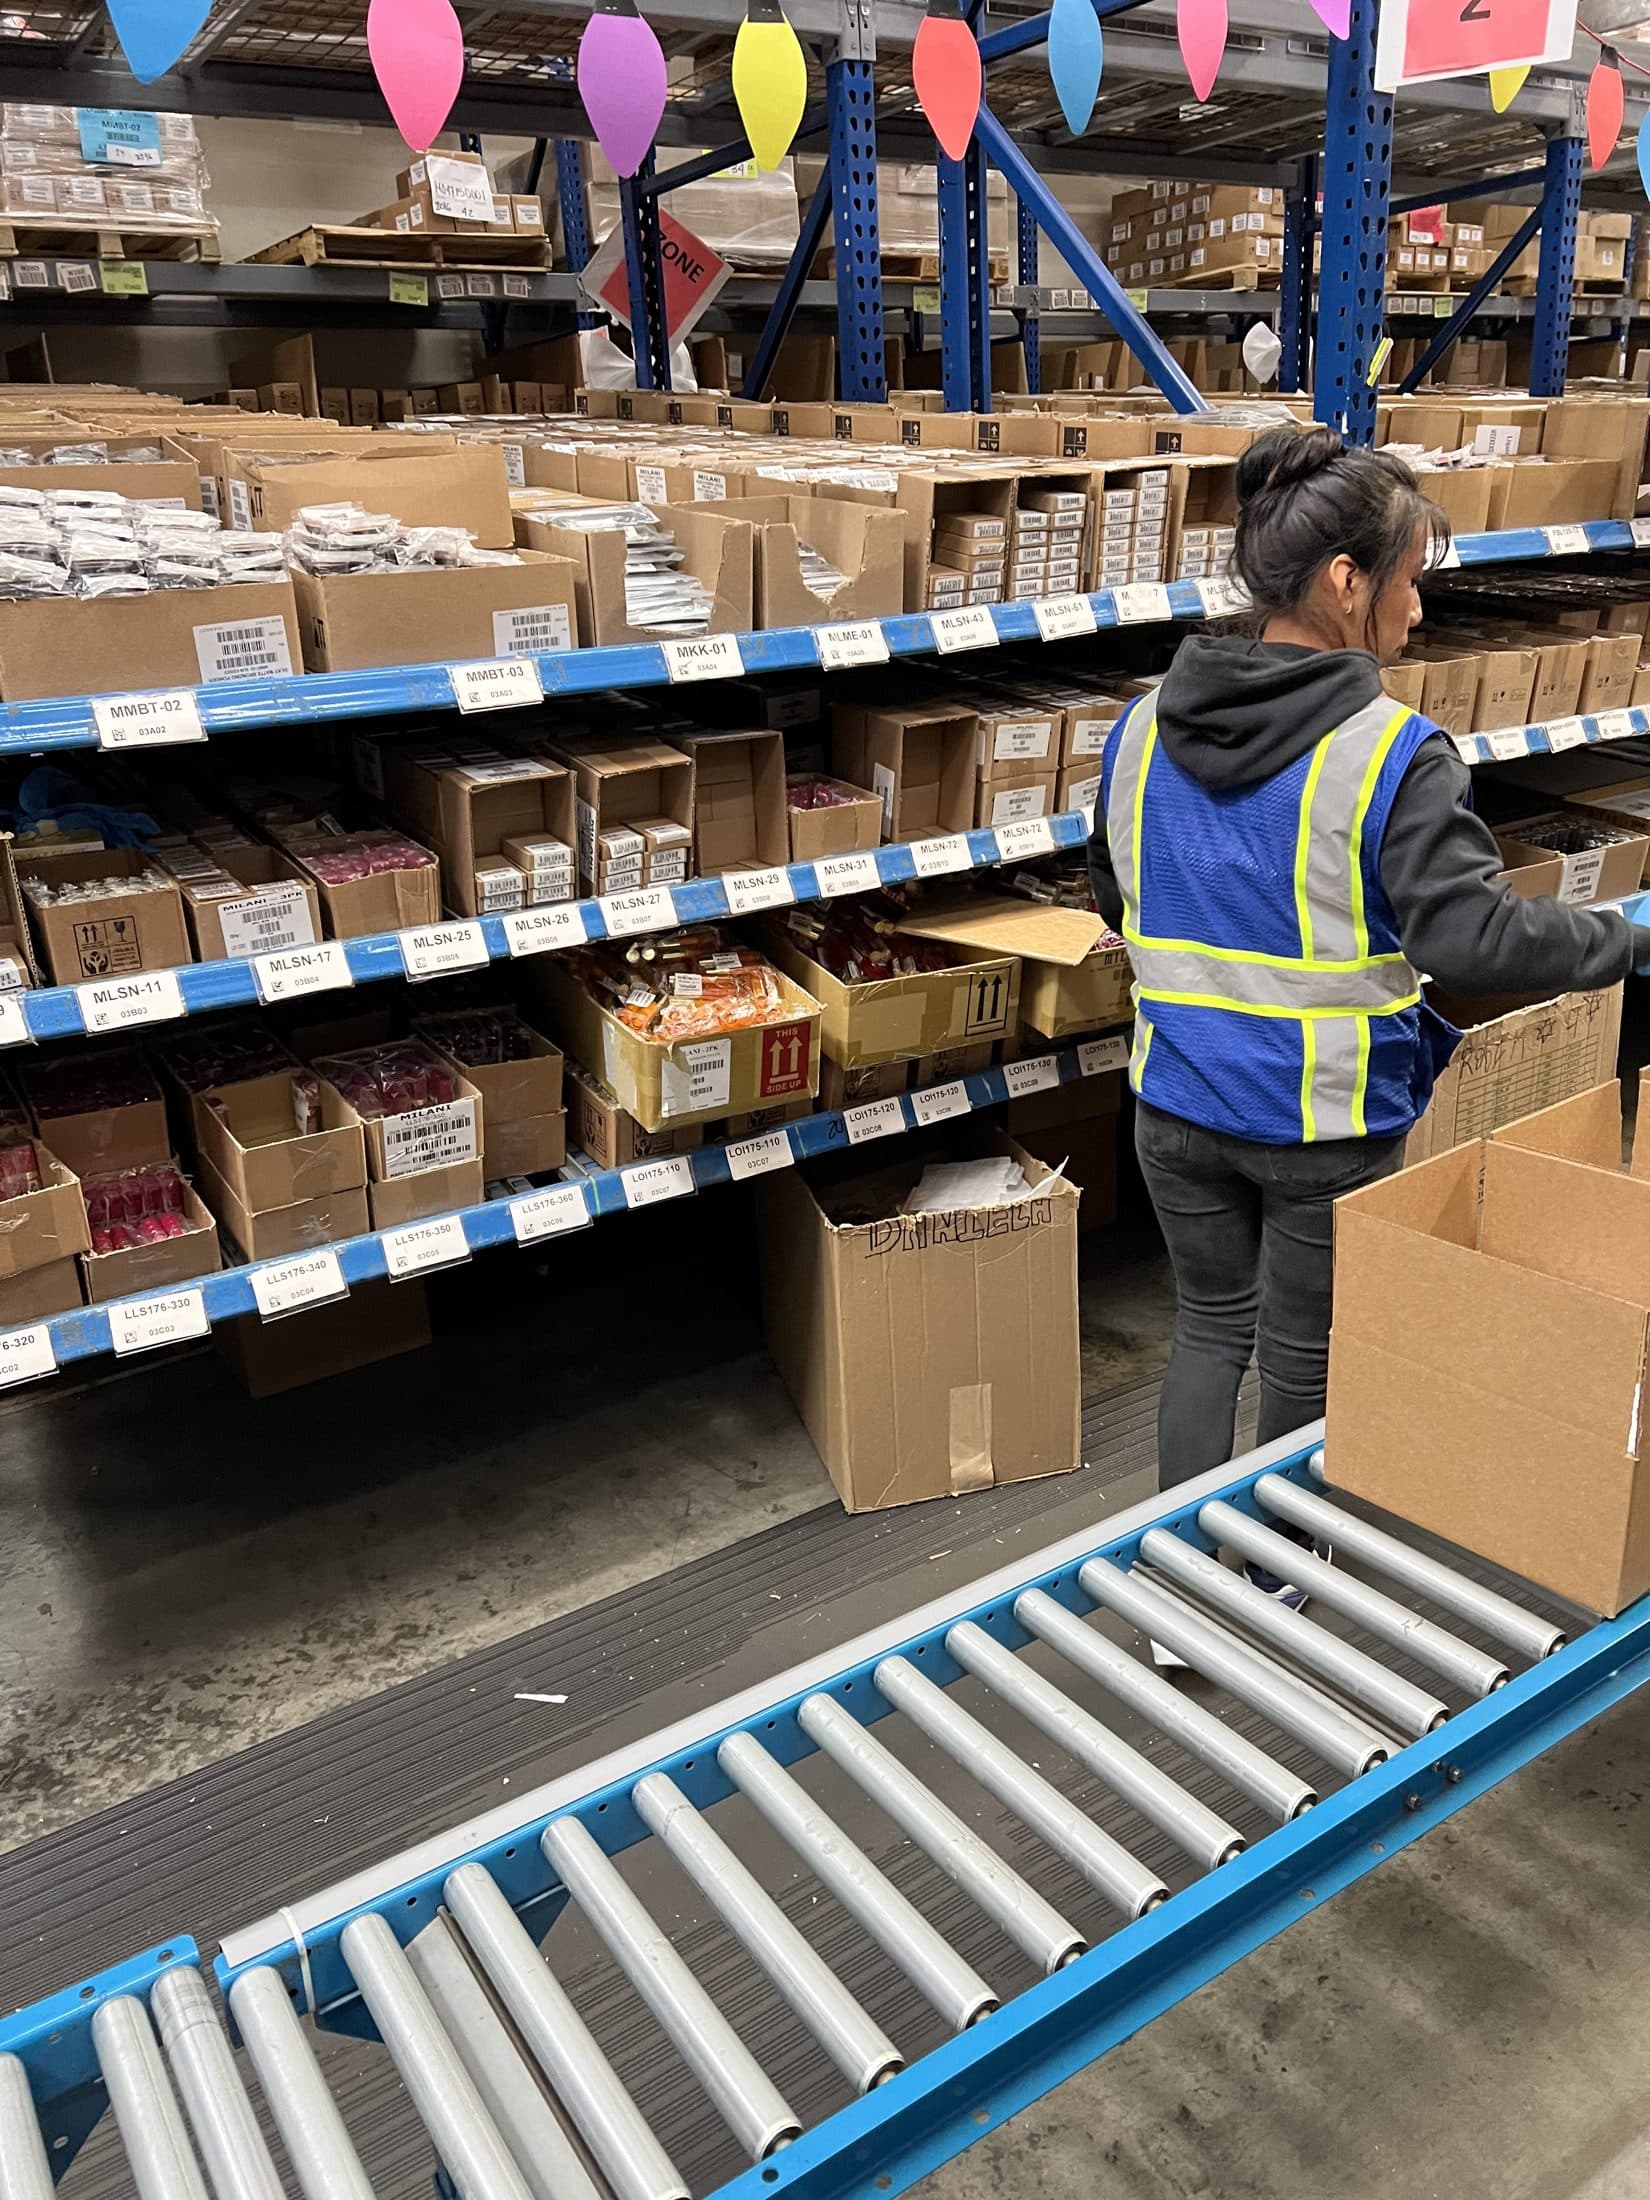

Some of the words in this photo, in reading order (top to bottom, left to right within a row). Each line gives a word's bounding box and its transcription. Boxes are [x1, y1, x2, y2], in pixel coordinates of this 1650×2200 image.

[697, 474, 721, 483] MILANI
[941, 614, 984, 630] MLSN-43
[677, 643, 727, 658] MKK-01
[466, 666, 524, 682] MMBT-03
[110, 700, 182, 719] MMBT-02
[139, 726, 166, 736] 03A02
[1003, 824, 1042, 839] MLSN-72
[920, 841, 958, 855] MLSN-72
[824, 859, 868, 876] MLSN-31
[733, 873, 780, 892] MLSN-29
[222, 899, 267, 912] MILANI
[611, 894, 661, 912] MLSN-27
[515, 913, 570, 932] MLSN-26
[413, 930, 472, 950] MLSN-25
[269, 951, 332, 973] MLSN-17
[93, 980, 163, 1004] MLSN-11
[120, 1007, 148, 1019] 03B03
[775, 1026, 798, 1039] THIS
[766, 1082, 788, 1094] SIDE
[789, 1079, 802, 1089] UP
[919, 1086, 959, 1104] LOI175-120
[400, 1104, 452, 1121] MILANI
[849, 1102, 895, 1122] LOI175-120
[728, 1137, 780, 1158] LOI175-110
[747, 1157, 770, 1169] 03C07
[631, 1163, 681, 1183] LOI175-110
[522, 1193, 575, 1214] LLS176-360
[395, 1224, 451, 1246] LLS176-350
[266, 1260, 327, 1285] LLS176-340
[290, 1287, 315, 1300] 03C04
[124, 1298, 191, 1320] LLS176-330
[148, 1325, 175, 1337] 03C03
[0, 1334, 36, 1351] 6-320
[0, 1363, 19, 1375] C02
